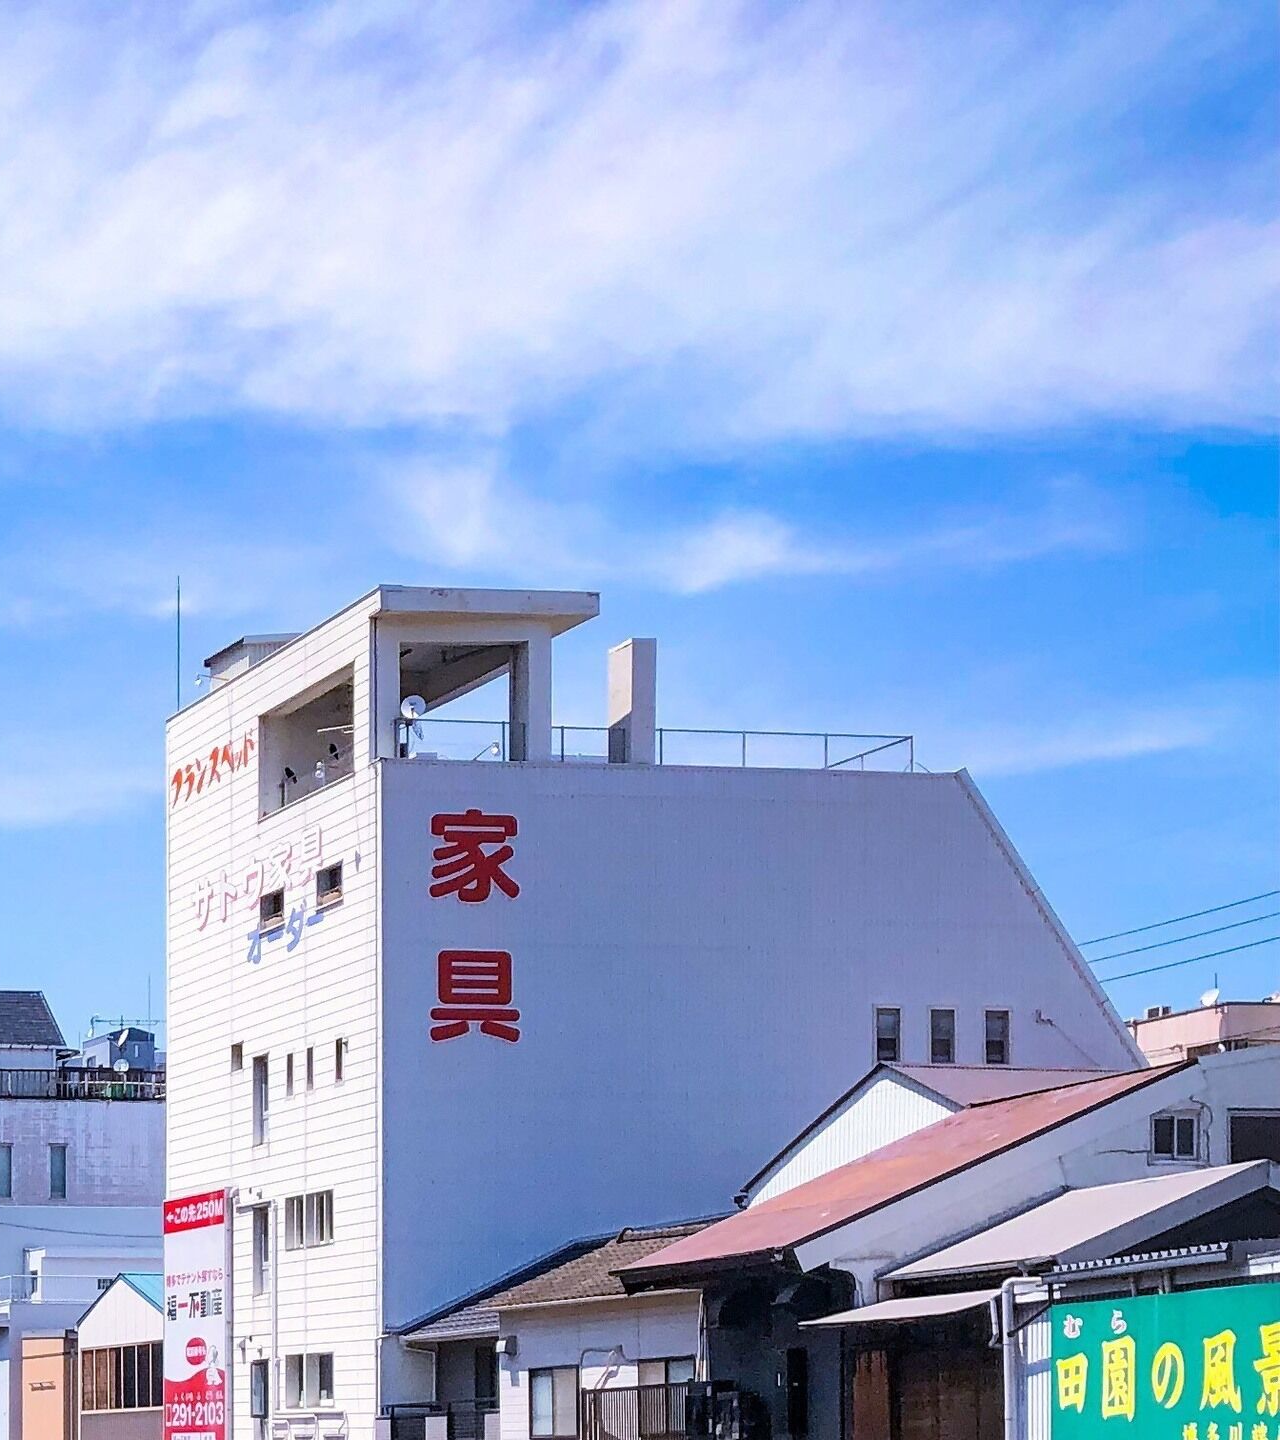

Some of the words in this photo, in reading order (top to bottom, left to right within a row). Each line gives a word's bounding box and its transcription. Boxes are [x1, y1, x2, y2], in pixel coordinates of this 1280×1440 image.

[171, 728, 255, 809] フランスベッド
[193, 824, 322, 932] サトウ家具
[247, 899, 324, 965] オーダー
[429, 809, 521, 1044] 家具
[1062, 1309, 1128, 1339] むら
[1056, 1321, 1280, 1423] 田園の風景
